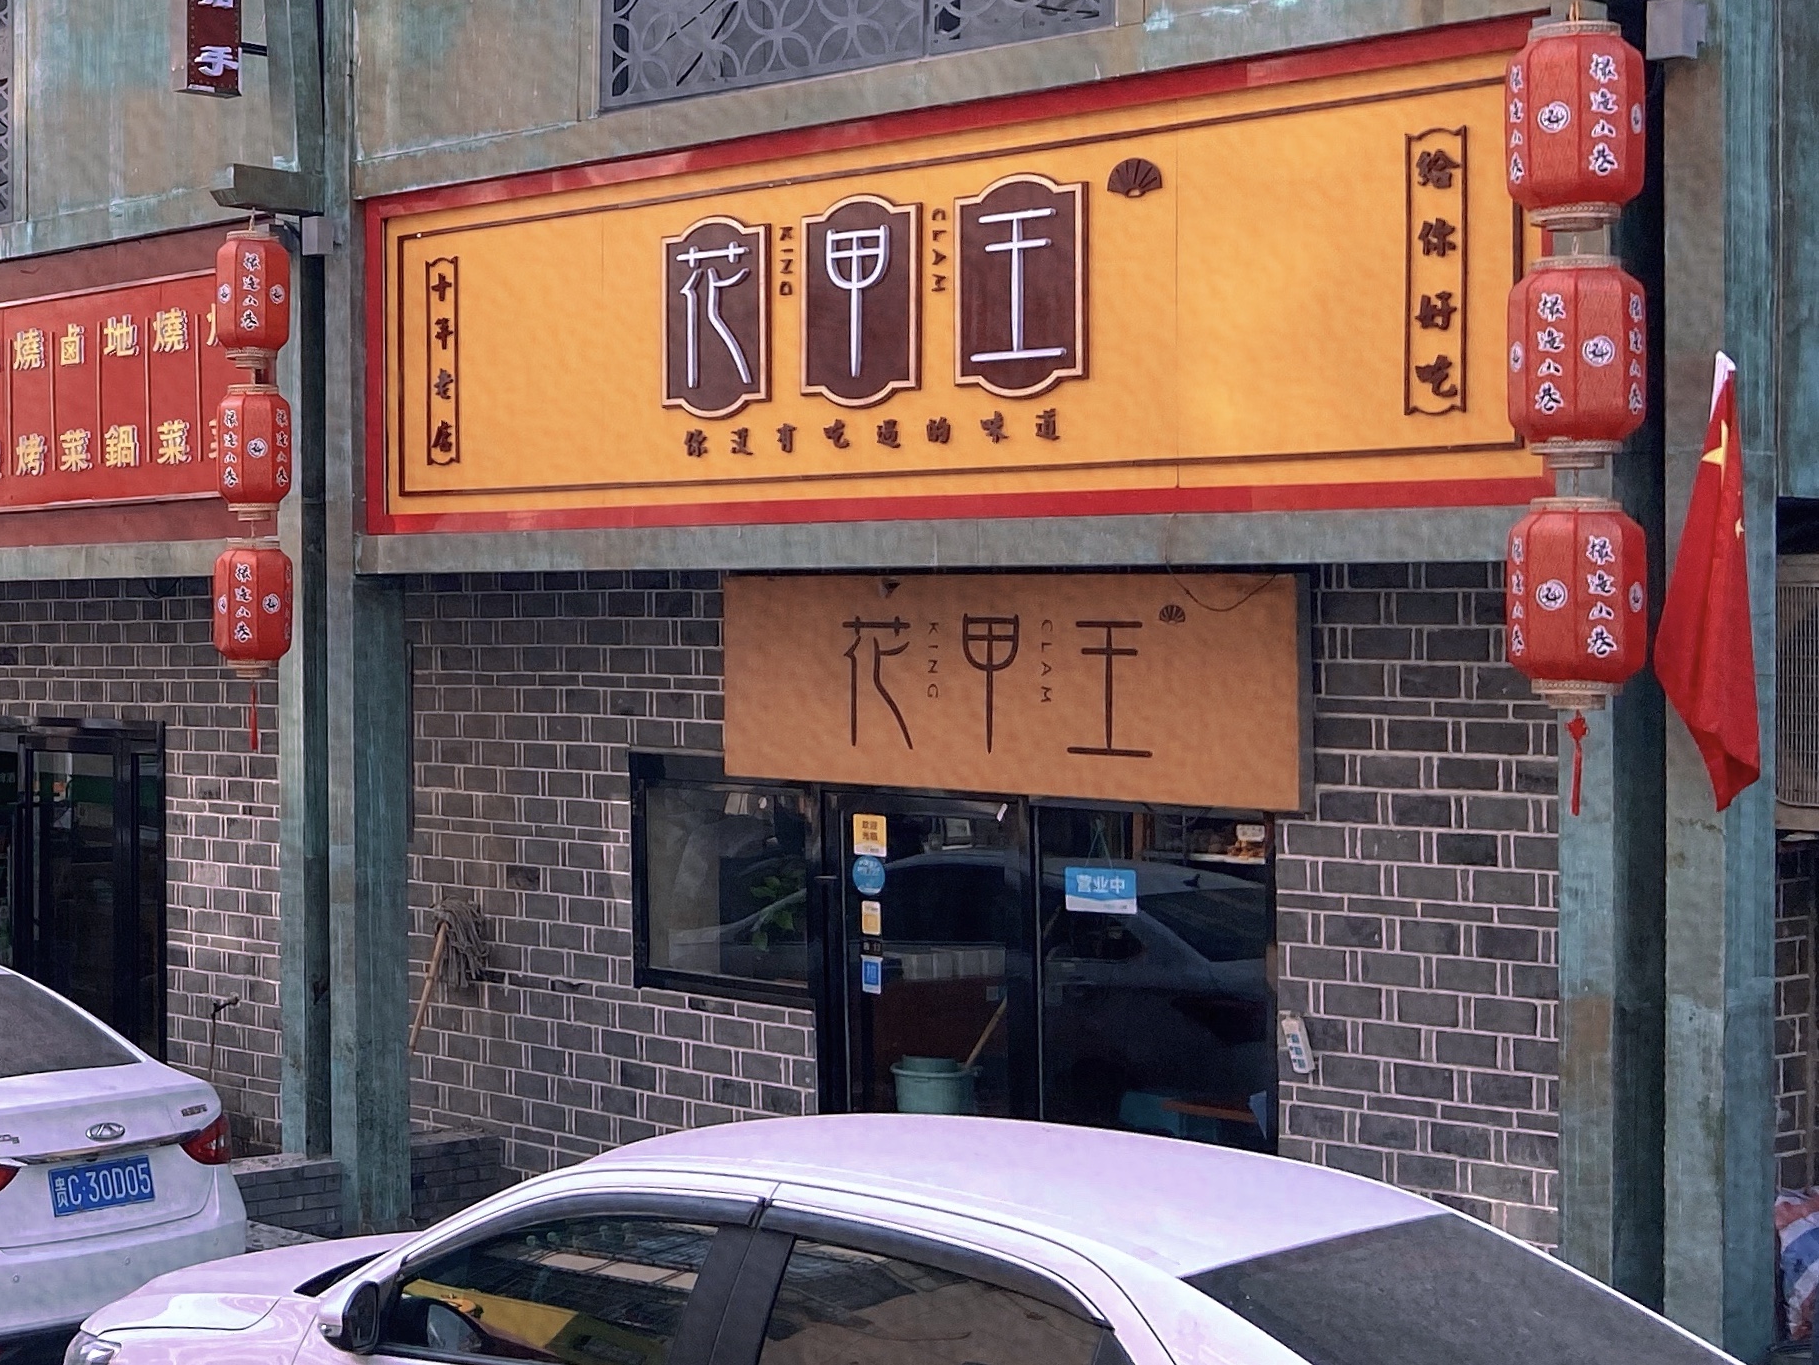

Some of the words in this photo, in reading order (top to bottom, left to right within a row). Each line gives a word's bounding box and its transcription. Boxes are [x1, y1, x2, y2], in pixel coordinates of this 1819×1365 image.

[779, 225, 795, 296] KING
[931, 208, 948, 294] CLAM
[1415, 149, 1460, 397] 给你好吃
[676, 207, 1067, 390] 花甲王
[431, 272, 454, 453] 十年老店
[842, 613, 1153, 757] 花甲王
[927, 621, 939, 699] KING
[1039, 619, 1052, 703] CLAM
[1076, 874, 1126, 895] 营业中
